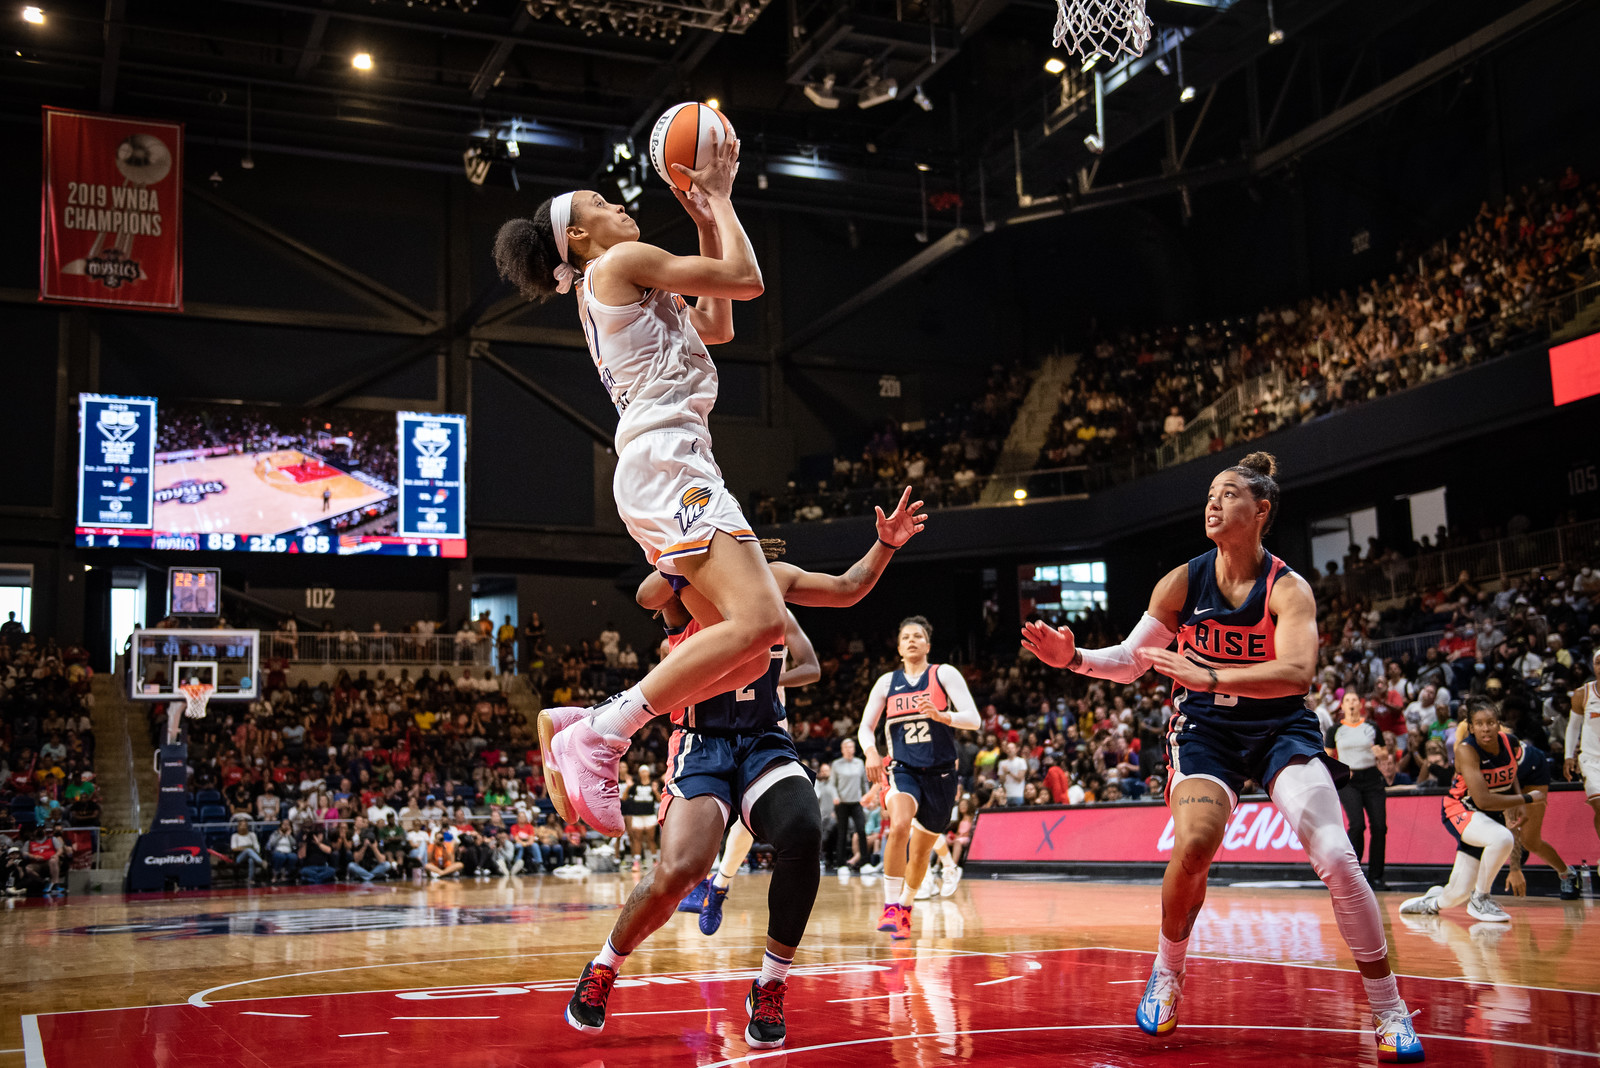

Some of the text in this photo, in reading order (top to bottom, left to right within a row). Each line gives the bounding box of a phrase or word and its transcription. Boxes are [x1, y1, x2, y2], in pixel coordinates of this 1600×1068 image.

[68, 182, 159, 211] 2019 WNBA
[64, 207, 162, 236] CHAMPIONS
[1567, 465, 1599, 496] 105
[207, 533, 236, 550] 85
[302, 535, 330, 553] 85
[305, 588, 335, 609] 102
[1195, 622, 1267, 657] RISE
[903, 721, 932, 744] 22
[1483, 767, 1514, 784] RISE
